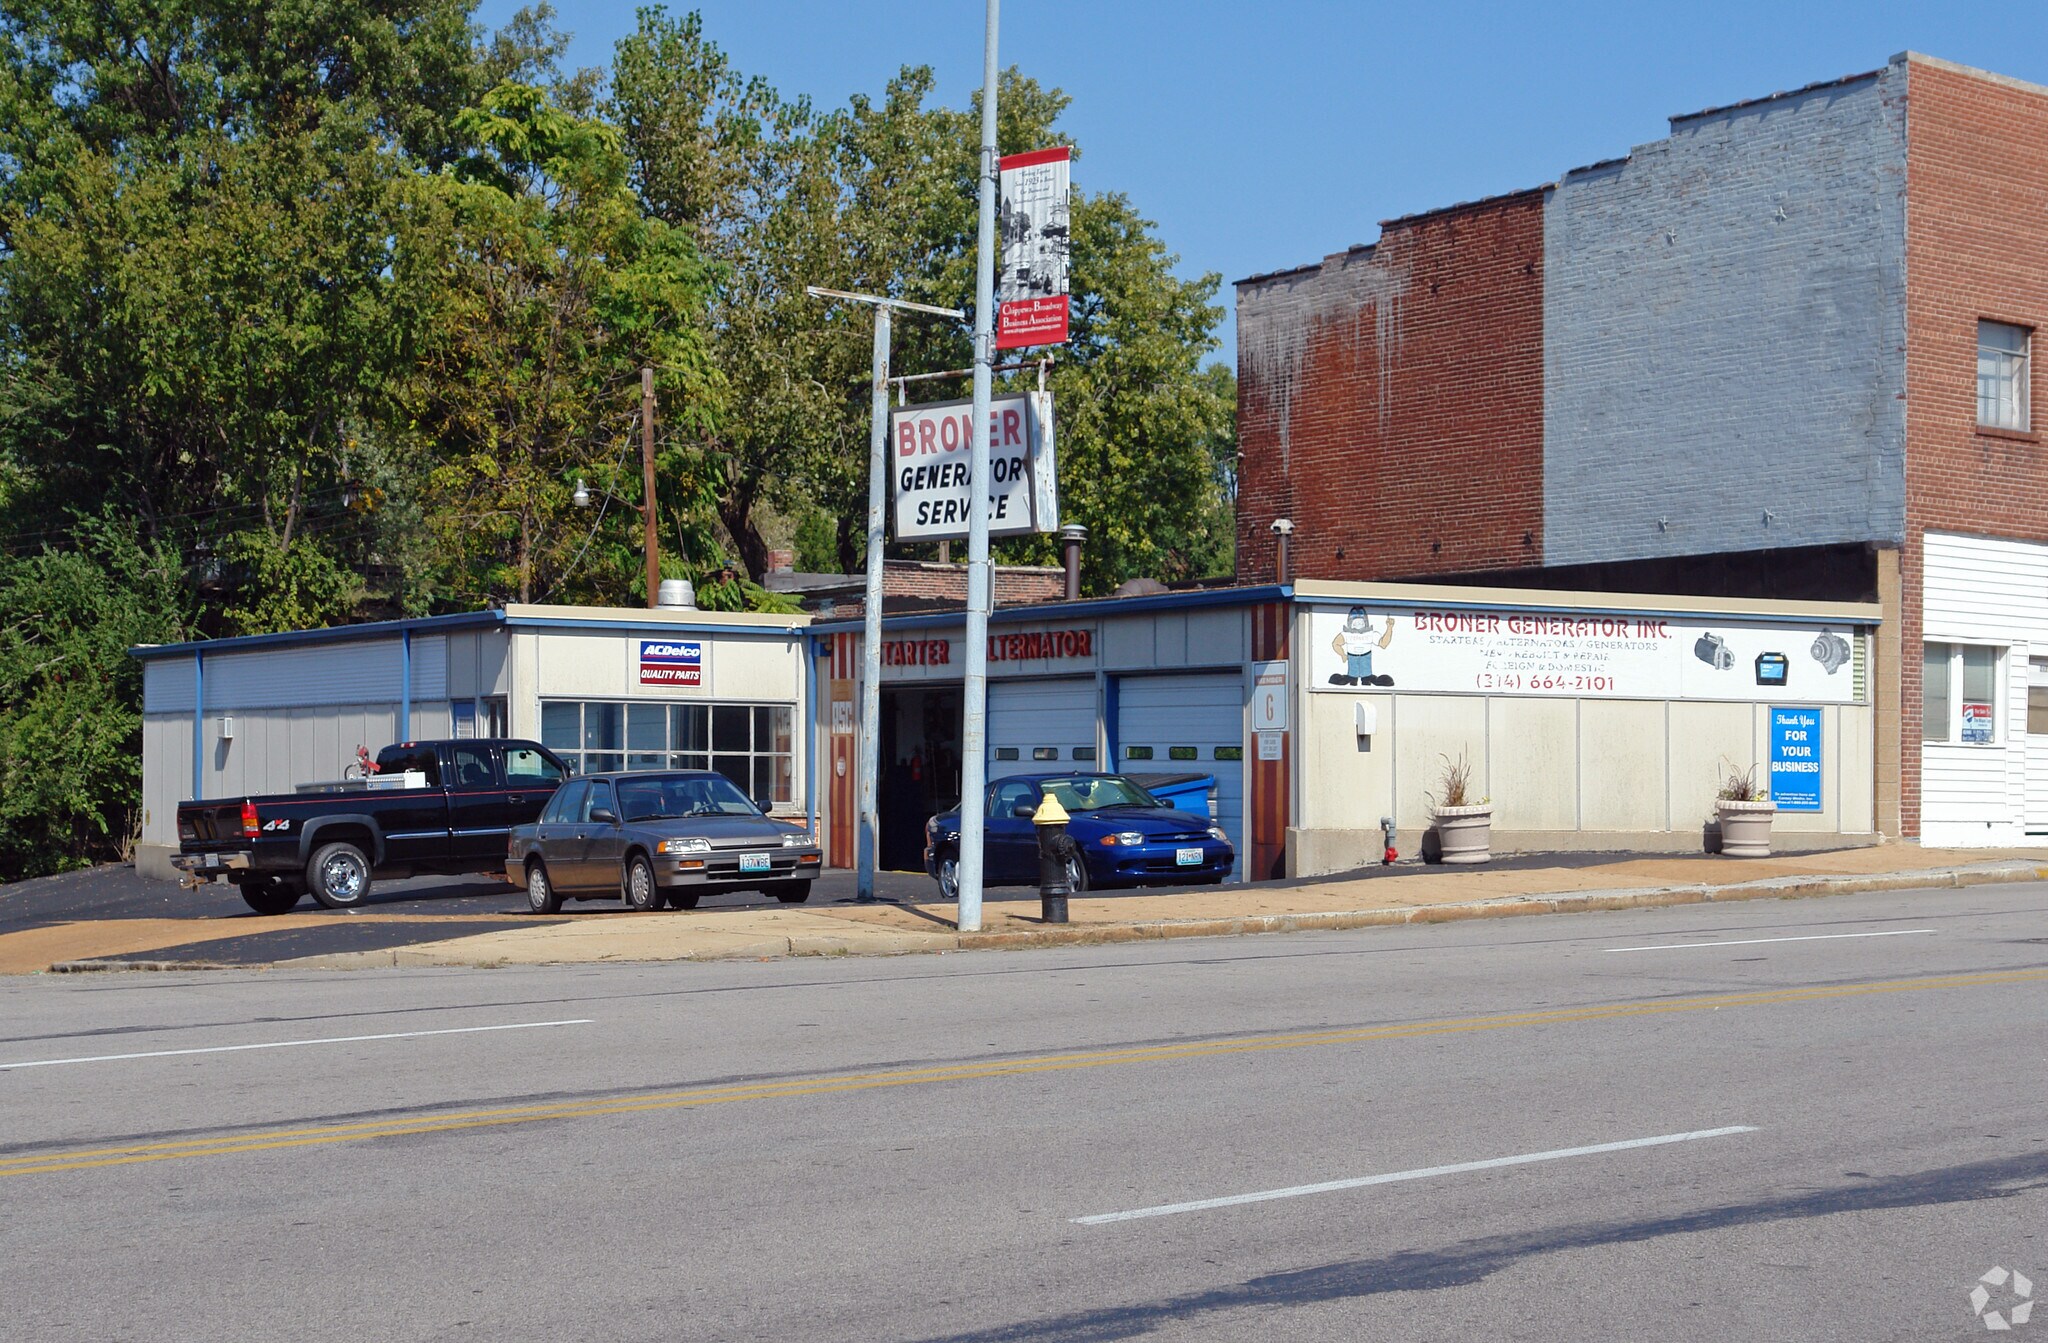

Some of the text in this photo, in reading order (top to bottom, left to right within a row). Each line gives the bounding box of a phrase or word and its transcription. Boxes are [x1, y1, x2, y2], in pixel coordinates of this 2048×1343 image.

[1024, 176, 1039, 186] 1923
[1003, 314, 1062, 328] Business Association
[901, 457, 1022, 492] GENEROR
[916, 494, 1009, 526] SERVCE
[1414, 612, 1673, 639] BRONER GENERATOR INC.
[987, 629, 1092, 662] LTERNATOR
[1429, 635, 1485, 645] STARTERS
[1586, 640, 1658, 650] GENERATORS
[643, 644, 700, 657] ACDelco
[881, 639, 950, 666] TARTER
[641, 669, 700, 680] QUALITY PARTS
[1548, 663, 1605, 672] DOMESTIC
[1530, 675, 1614, 691] 664-2101
[1776, 714, 1815, 728] Thank You
[1785, 730, 1807, 741] FOR
[1781, 746, 1811, 757] YOUR
[1771, 761, 1819, 773] BUSINESS
